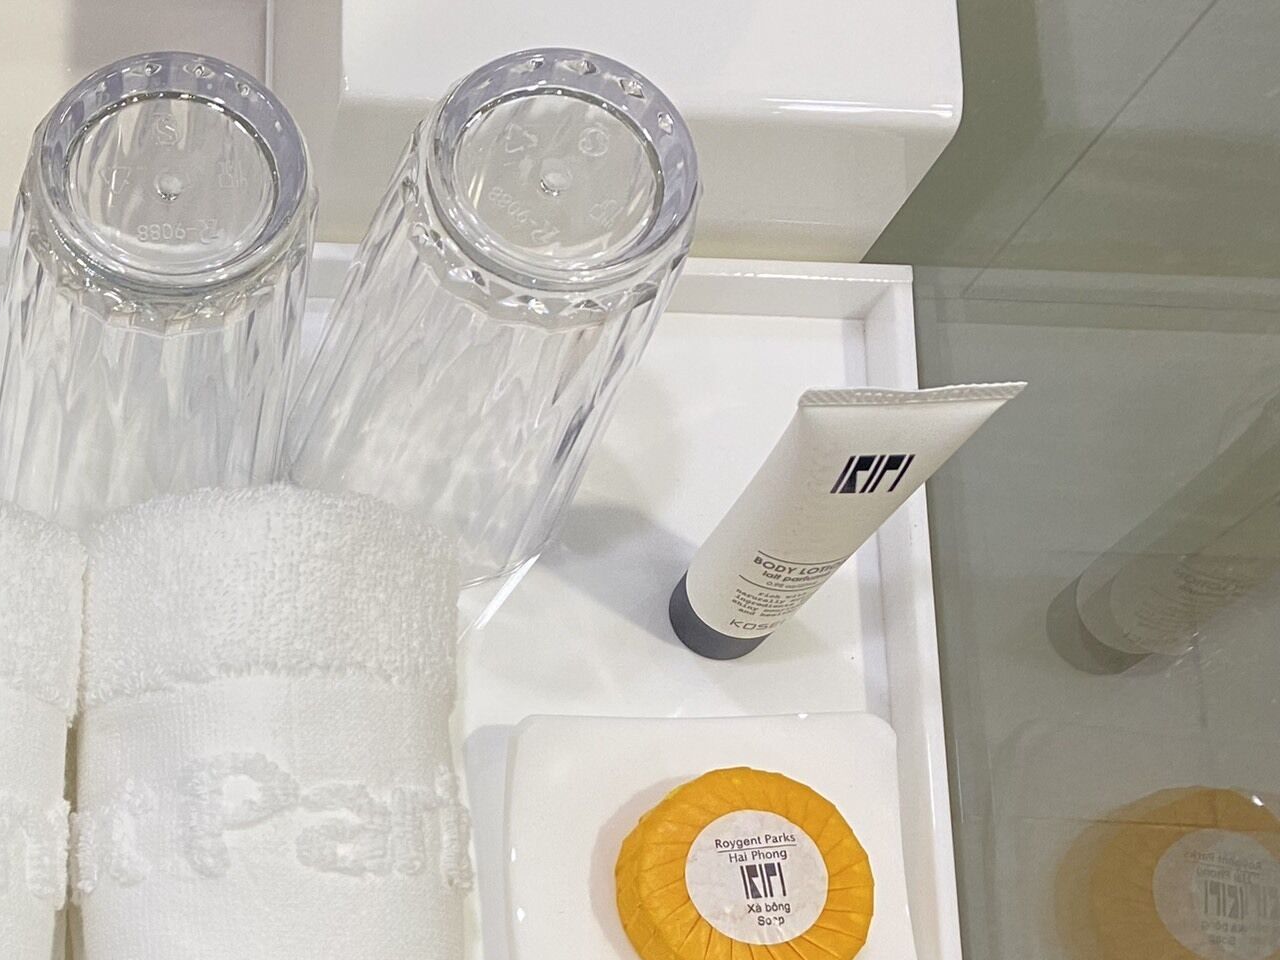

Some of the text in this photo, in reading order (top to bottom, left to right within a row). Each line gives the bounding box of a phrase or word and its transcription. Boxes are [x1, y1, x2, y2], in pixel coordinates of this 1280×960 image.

[753, 556, 797, 574] BODY
[715, 833, 796, 849] Roygent Parks
[729, 850, 788, 863] Hai Phong
[765, 902, 791, 913] bông
